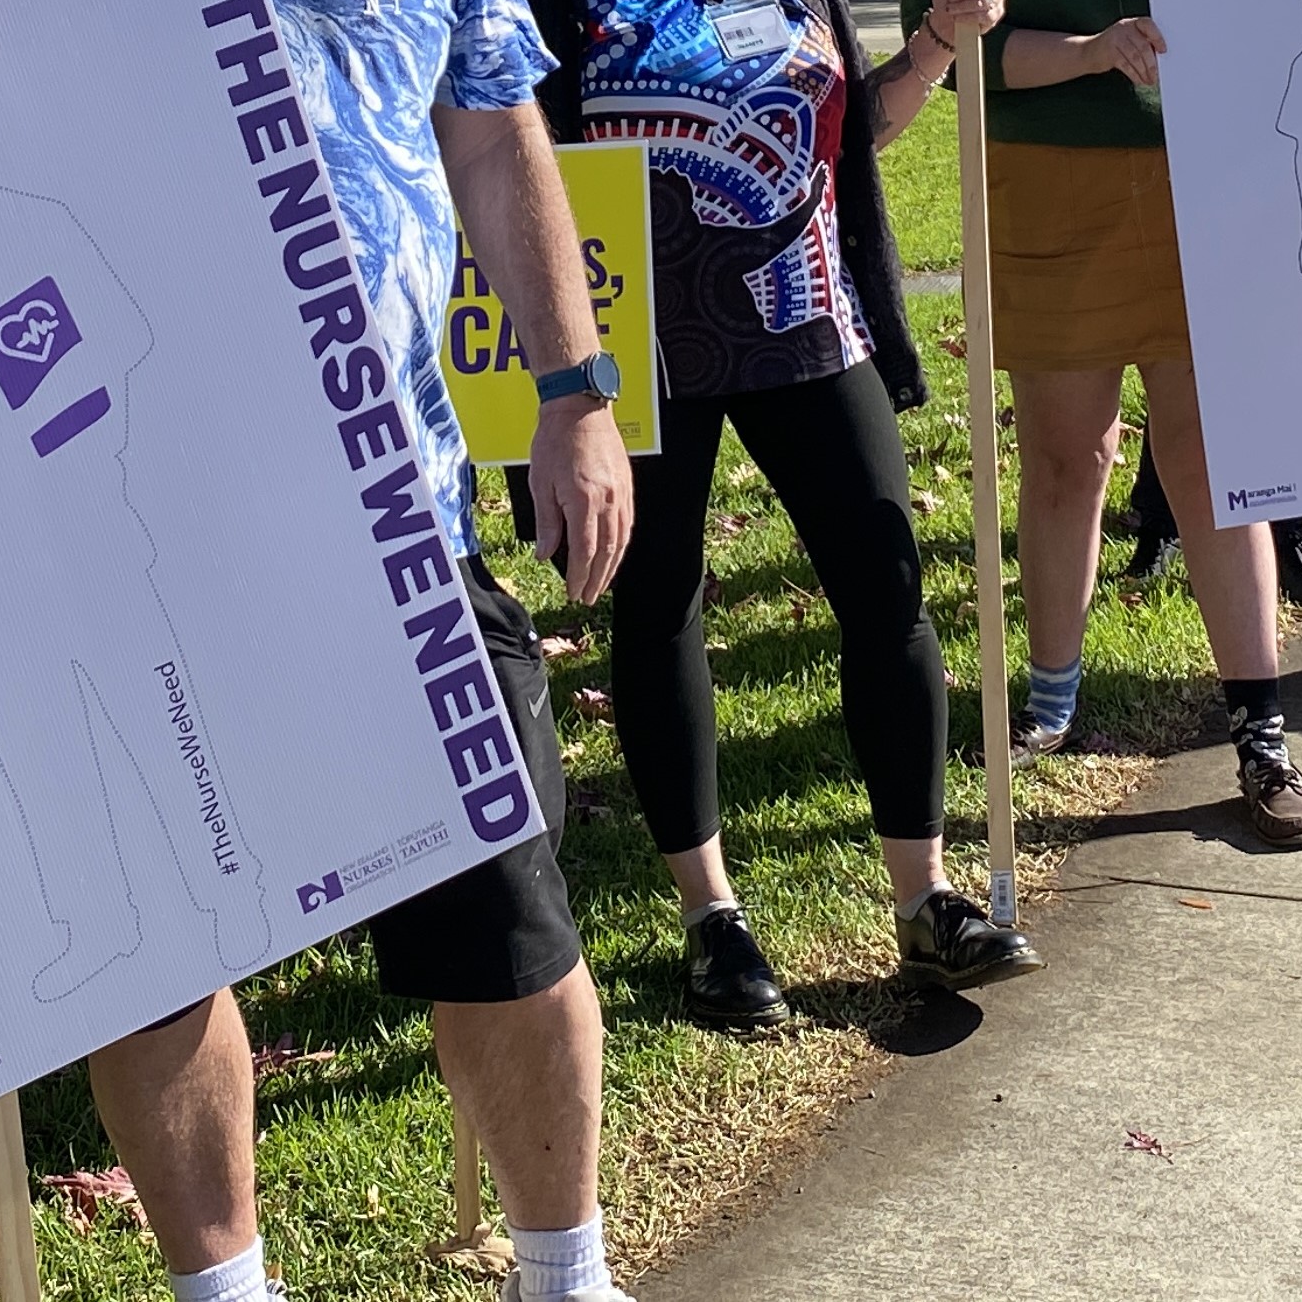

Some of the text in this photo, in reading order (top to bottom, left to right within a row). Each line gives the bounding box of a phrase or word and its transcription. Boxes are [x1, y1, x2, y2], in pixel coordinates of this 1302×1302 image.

[1227, 488, 1275, 511] Maranga
[154, 660, 240, 876] #TheNurseWeNeed
[399, 828, 449, 858] TAPUHI
[343, 854, 393, 885] NURSES
